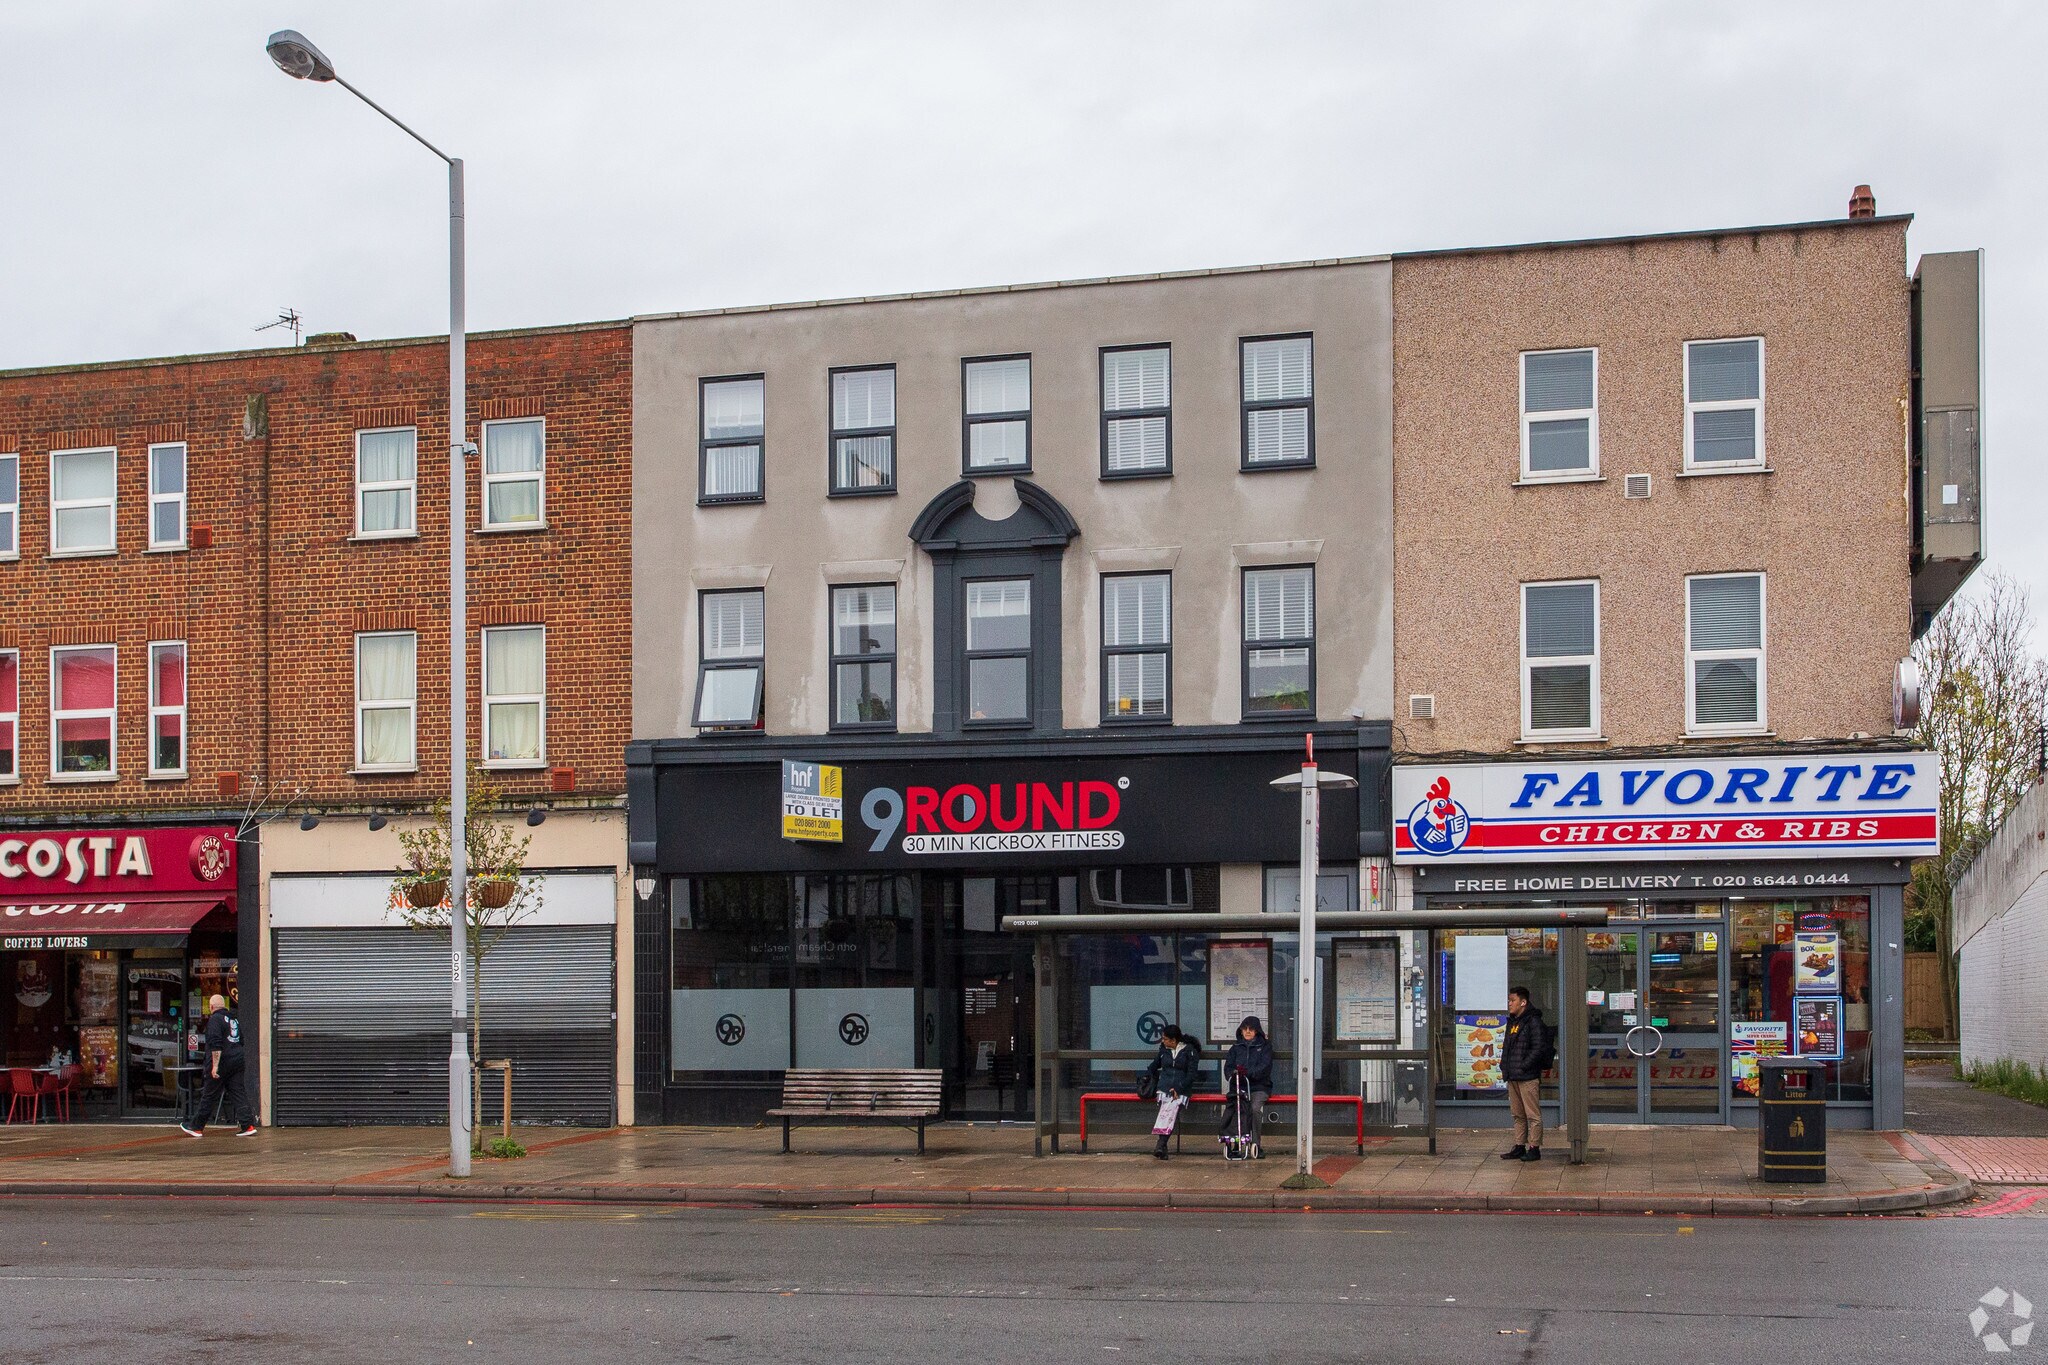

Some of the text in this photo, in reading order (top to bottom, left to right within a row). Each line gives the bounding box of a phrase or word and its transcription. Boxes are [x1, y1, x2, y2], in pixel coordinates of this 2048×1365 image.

[791, 763, 813, 787] hnf
[1509, 764, 1916, 808] FAVORITE
[785, 804, 841, 819] TO LET
[794, 817, 805, 827] 020
[817, 820, 831, 830] 2000
[786, 828, 840, 838] www.hnfproperty.com
[1539, 820, 1879, 843] CHICKEN & RIBS
[202, 838, 220, 852] COSTA
[906, 832, 1121, 851] 30 MIN KICKBOX FITNESS
[0, 836, 153, 884] COSTA
[202, 862, 224, 878] COFFEE
[1454, 873, 1850, 892] FREE HOME DELIVERY T. 020 8644 0444
[4, 936, 88, 949] COFFEE LOVERS
[1800, 945, 1815, 953] BOX
[143, 1027, 169, 1036] COSTA
[1667, 1065, 1717, 1079] RIB
